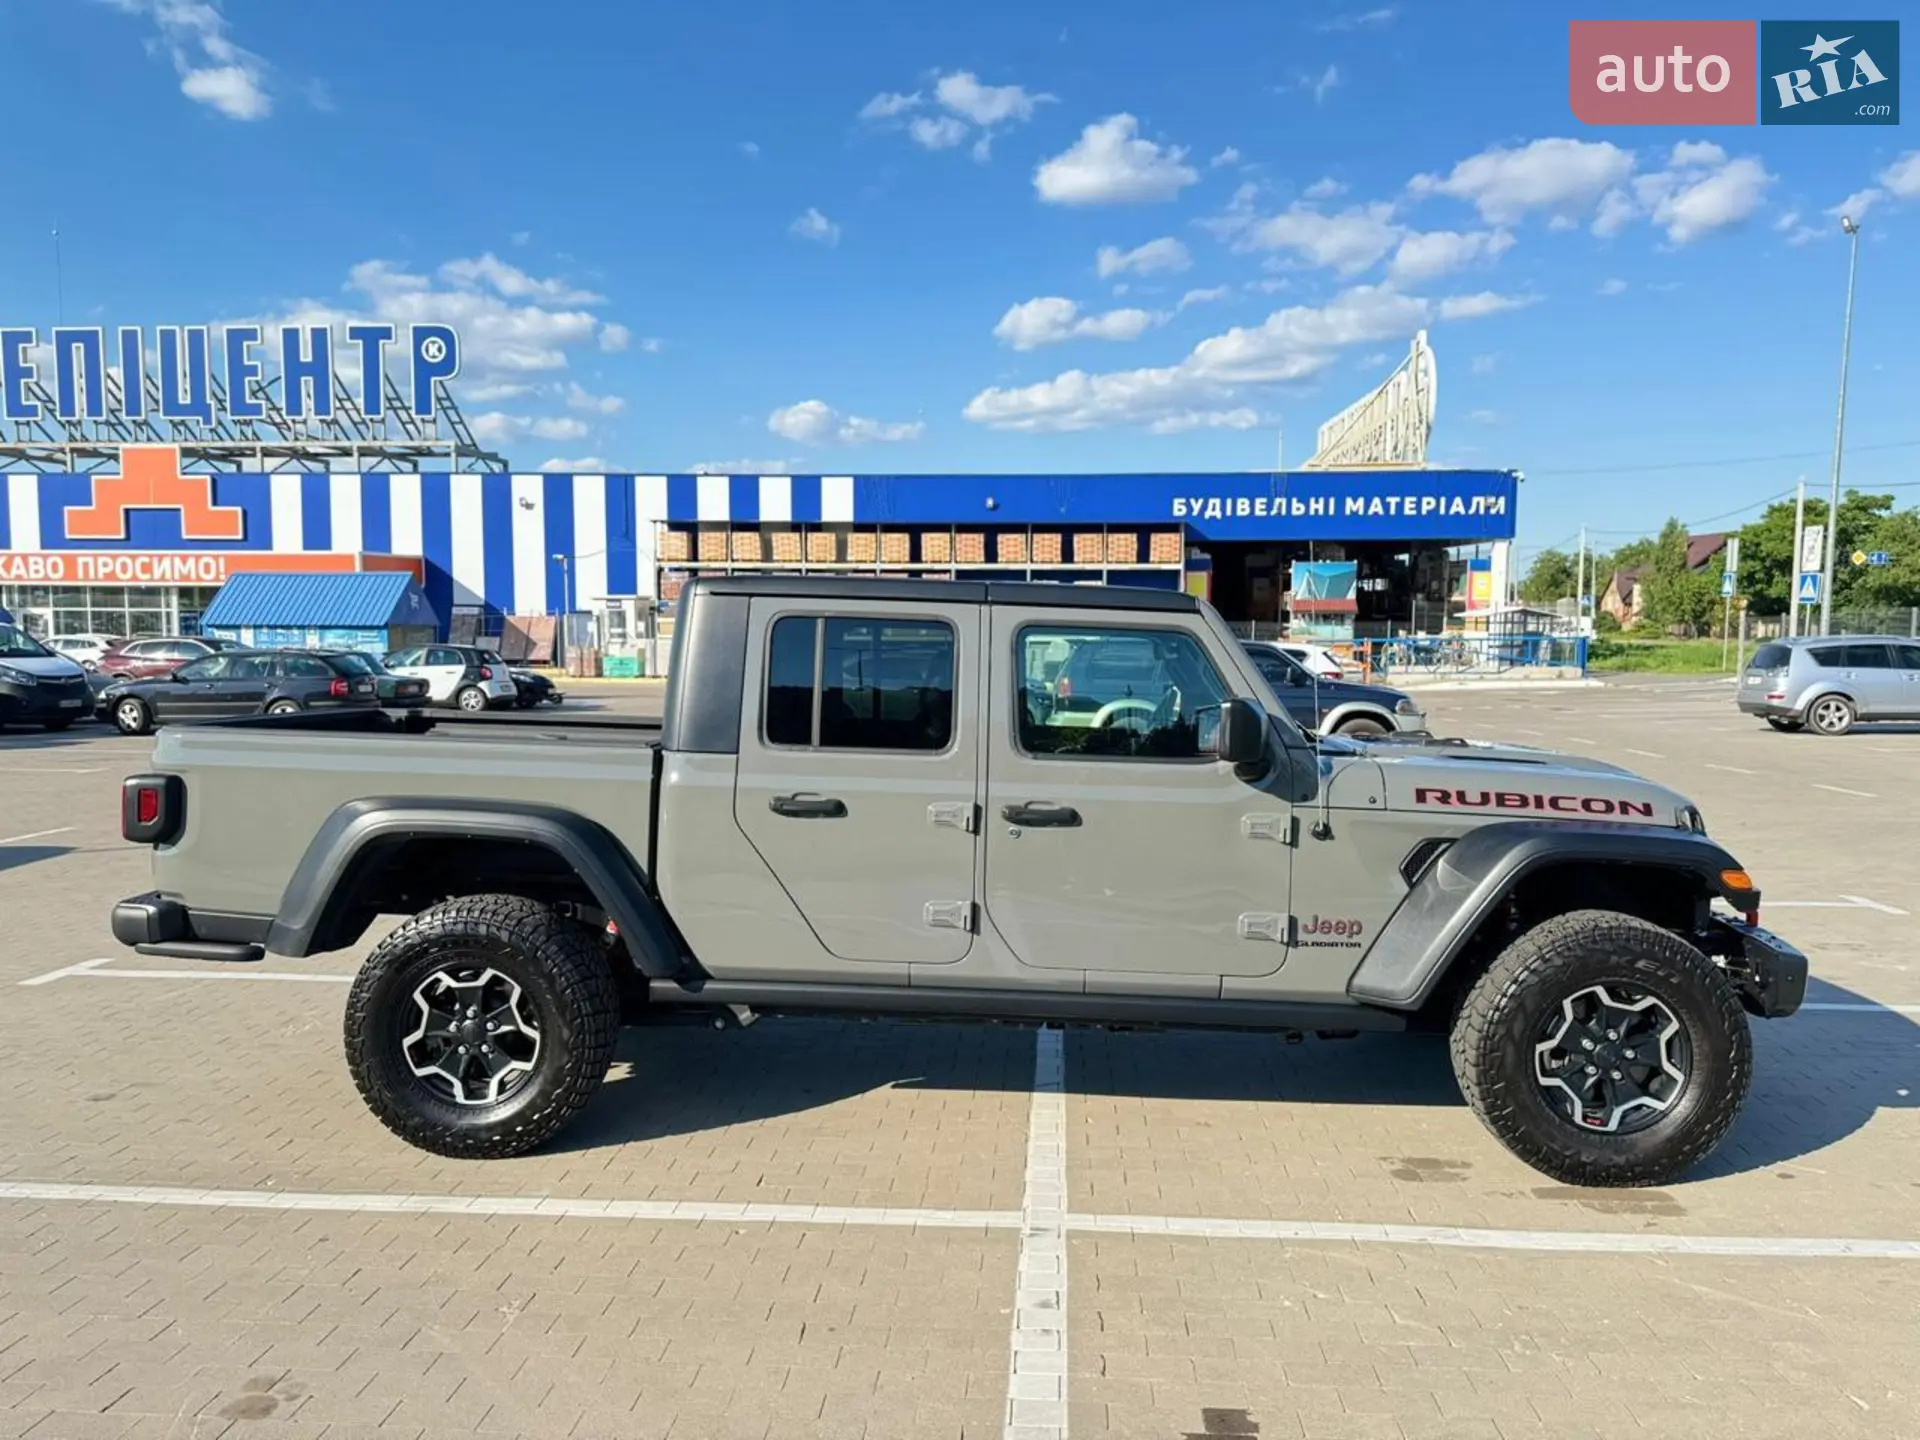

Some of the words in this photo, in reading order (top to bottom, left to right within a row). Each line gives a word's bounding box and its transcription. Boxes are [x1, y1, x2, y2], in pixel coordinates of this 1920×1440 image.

[0, 323, 460, 427] ЕПІЦЕНТР
[1172, 497, 1335, 519] БУДІВЕЛЬНІ
[1345, 496, 1506, 516] МАТЕРІАЛИ
[77, 556, 226, 580] ПРОСИМО!
[1414, 787, 1654, 817] RUBICON
[1302, 914, 1363, 939] Jeep
